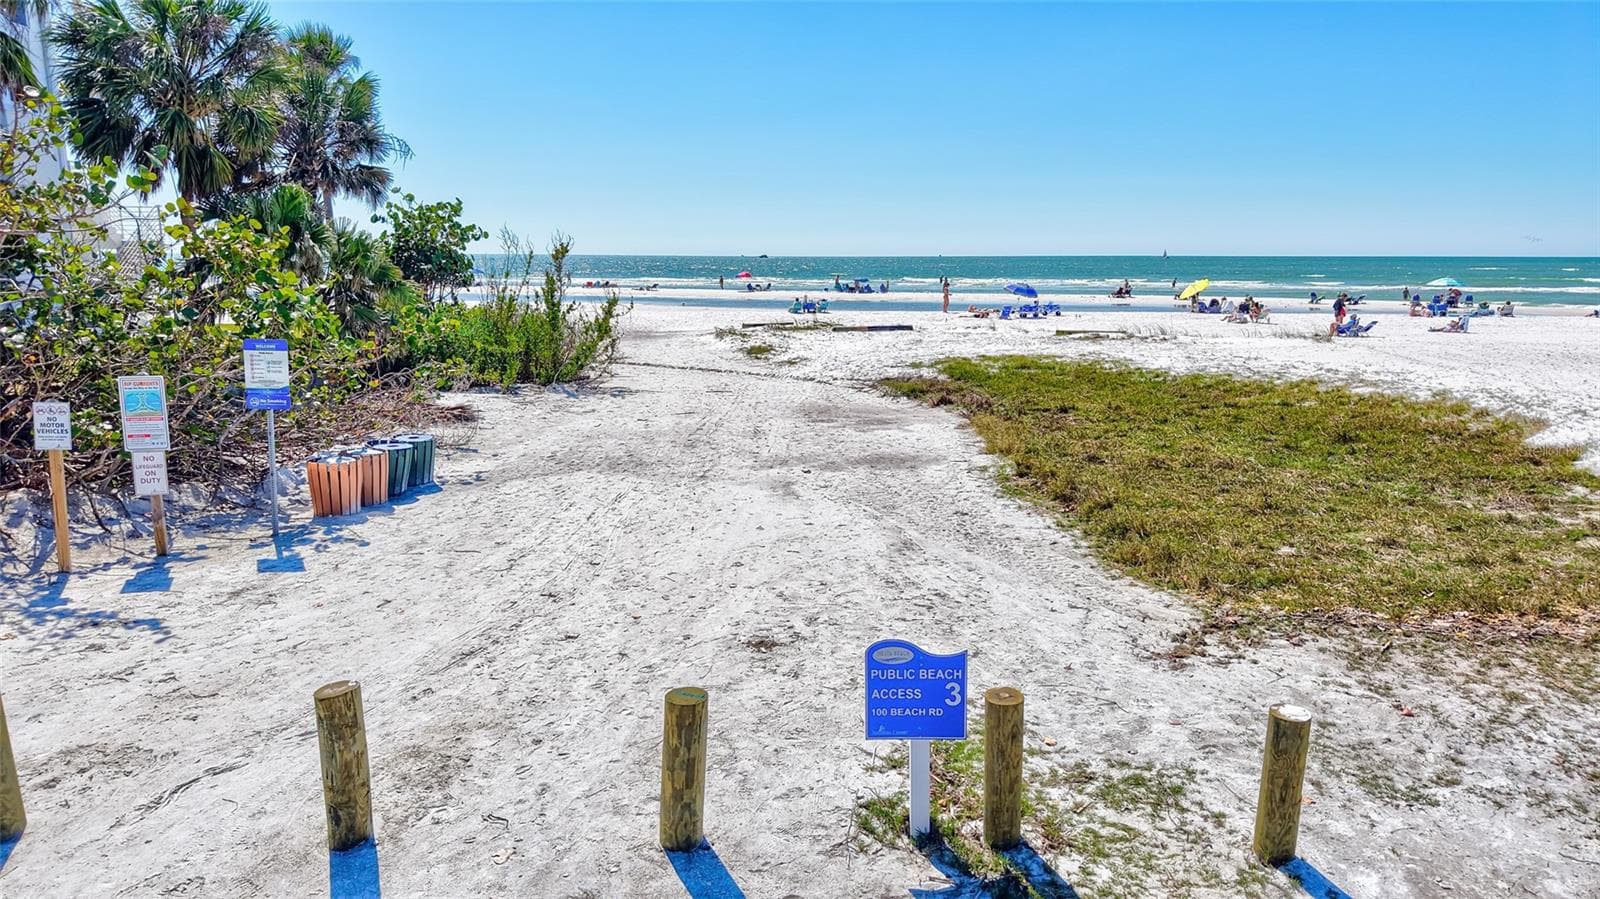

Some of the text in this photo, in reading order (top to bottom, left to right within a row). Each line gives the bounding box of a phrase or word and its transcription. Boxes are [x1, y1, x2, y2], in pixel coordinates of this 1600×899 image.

[871, 669, 962, 680] PUBLIC BEACH
[871, 689, 922, 699] ACCESS
[944, 682, 962, 706] 3
[872, 708, 944, 716] 100 BEACH RD
